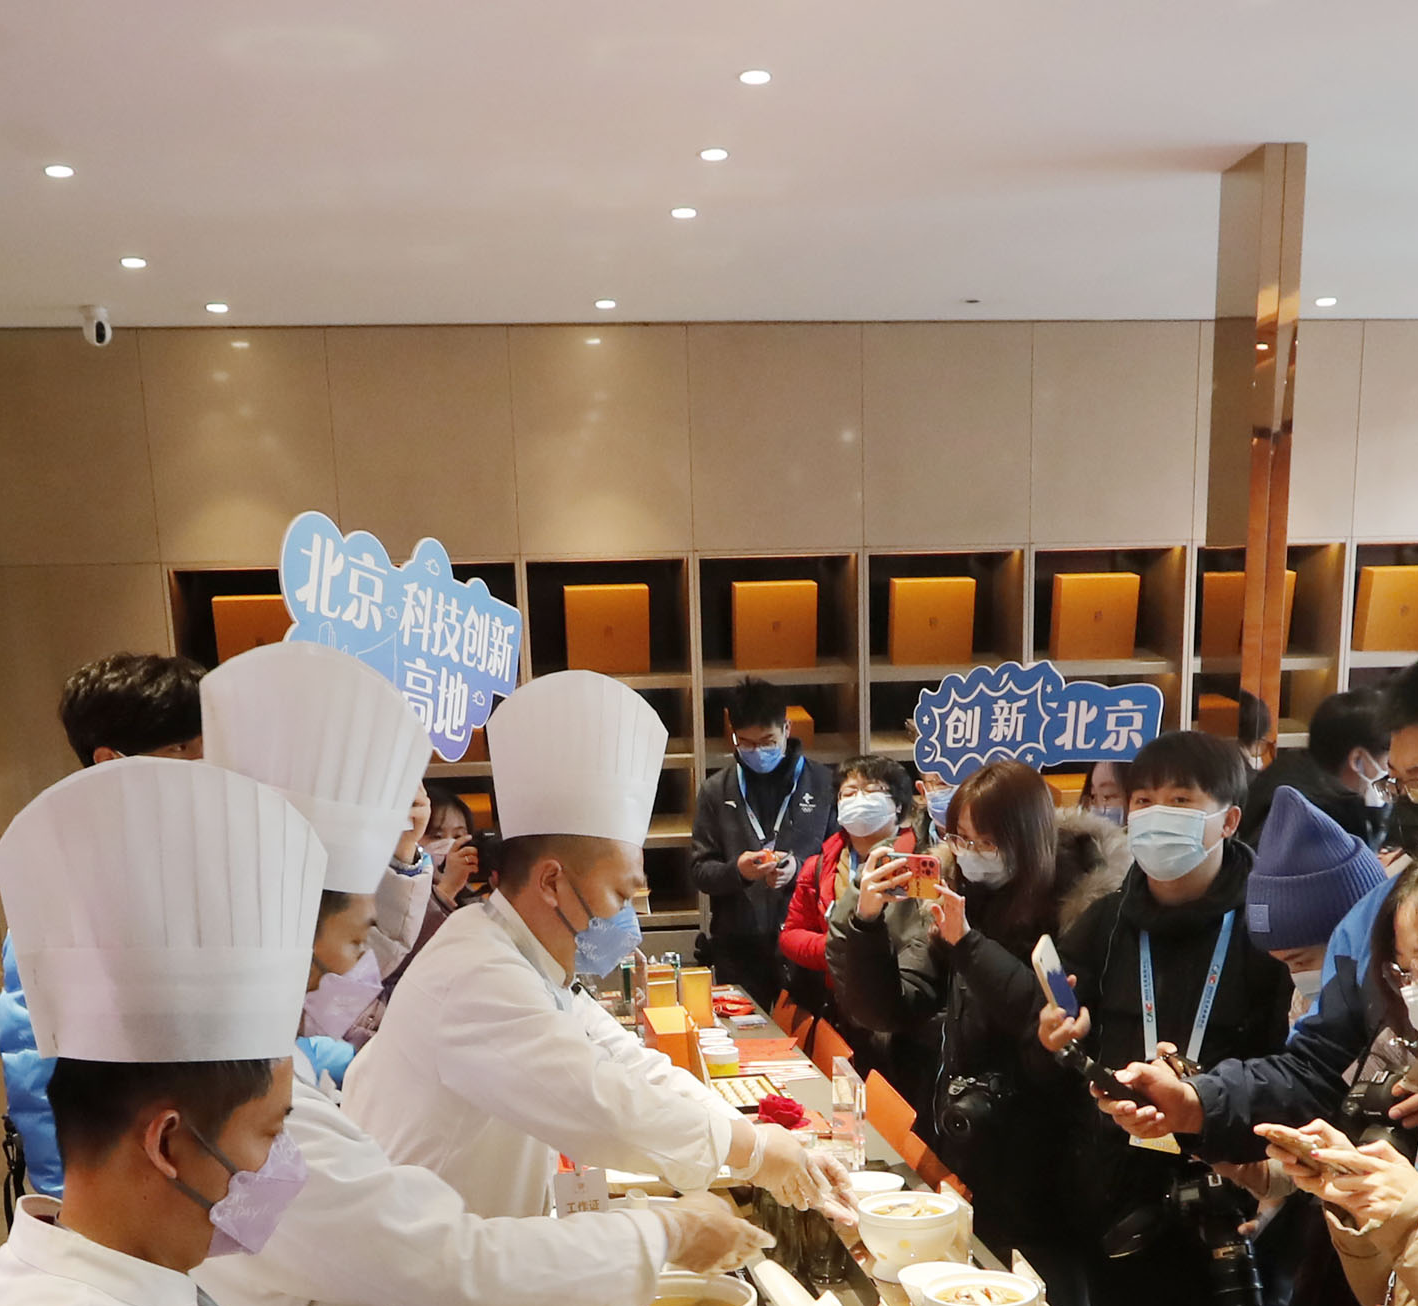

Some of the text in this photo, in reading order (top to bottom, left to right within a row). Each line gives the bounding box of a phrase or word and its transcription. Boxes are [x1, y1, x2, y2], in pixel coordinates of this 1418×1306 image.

[294, 532, 515, 684] 北京 科技创新
[401, 657, 469, 743] 高地
